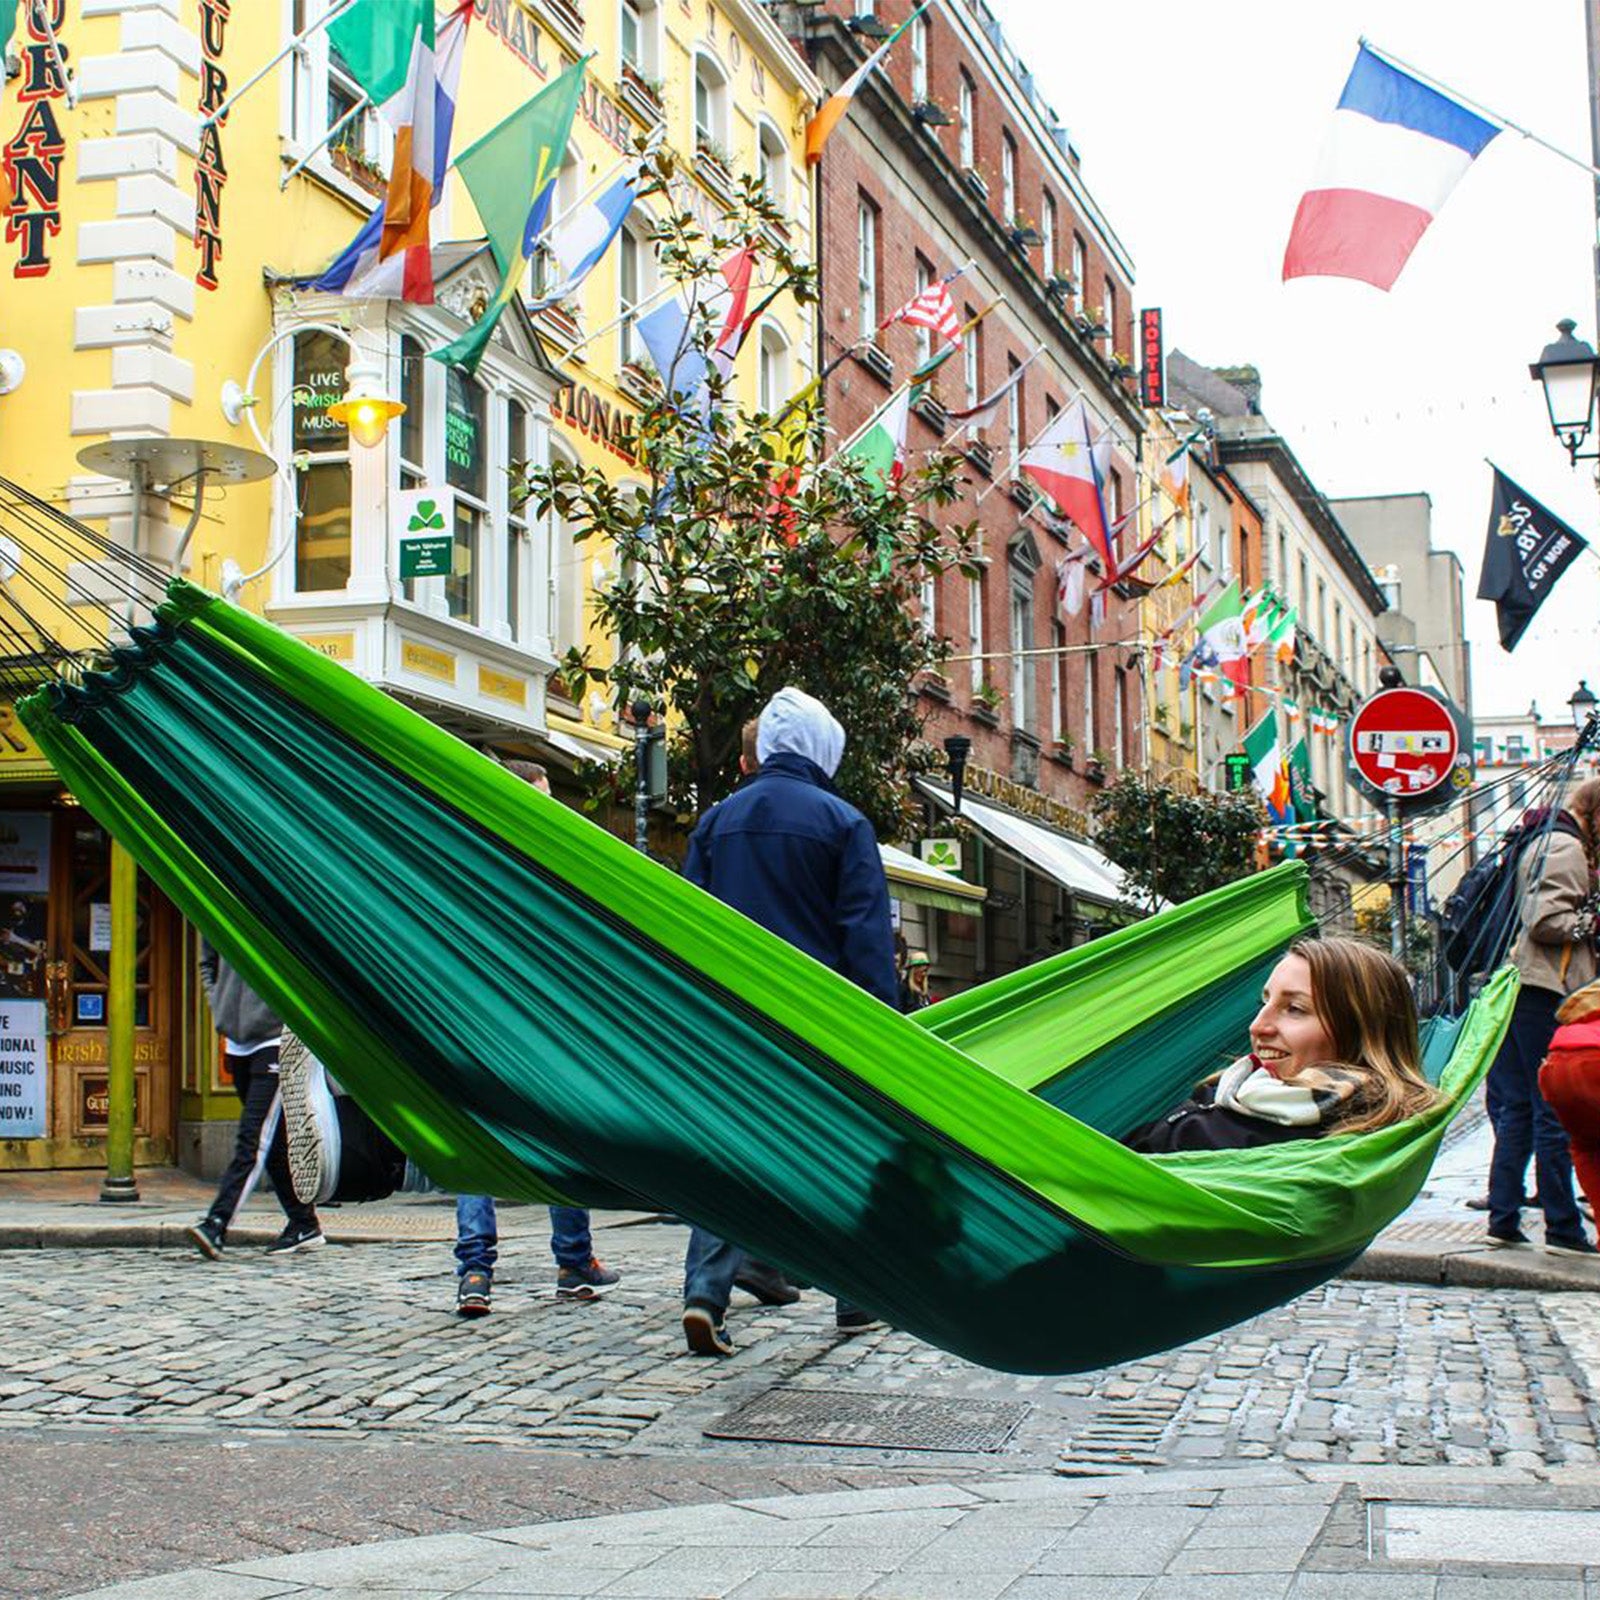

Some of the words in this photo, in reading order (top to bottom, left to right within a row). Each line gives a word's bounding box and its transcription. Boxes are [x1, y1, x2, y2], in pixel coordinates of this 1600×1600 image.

[194, 0, 230, 291] URANT
[1145, 311, 1161, 403] HOSTEL
[309, 372, 340, 387] LIVE
[1509, 501, 1532, 527] SS
[1544, 535, 1572, 564] MORE
[1, 1038, 36, 1052] IONAL
